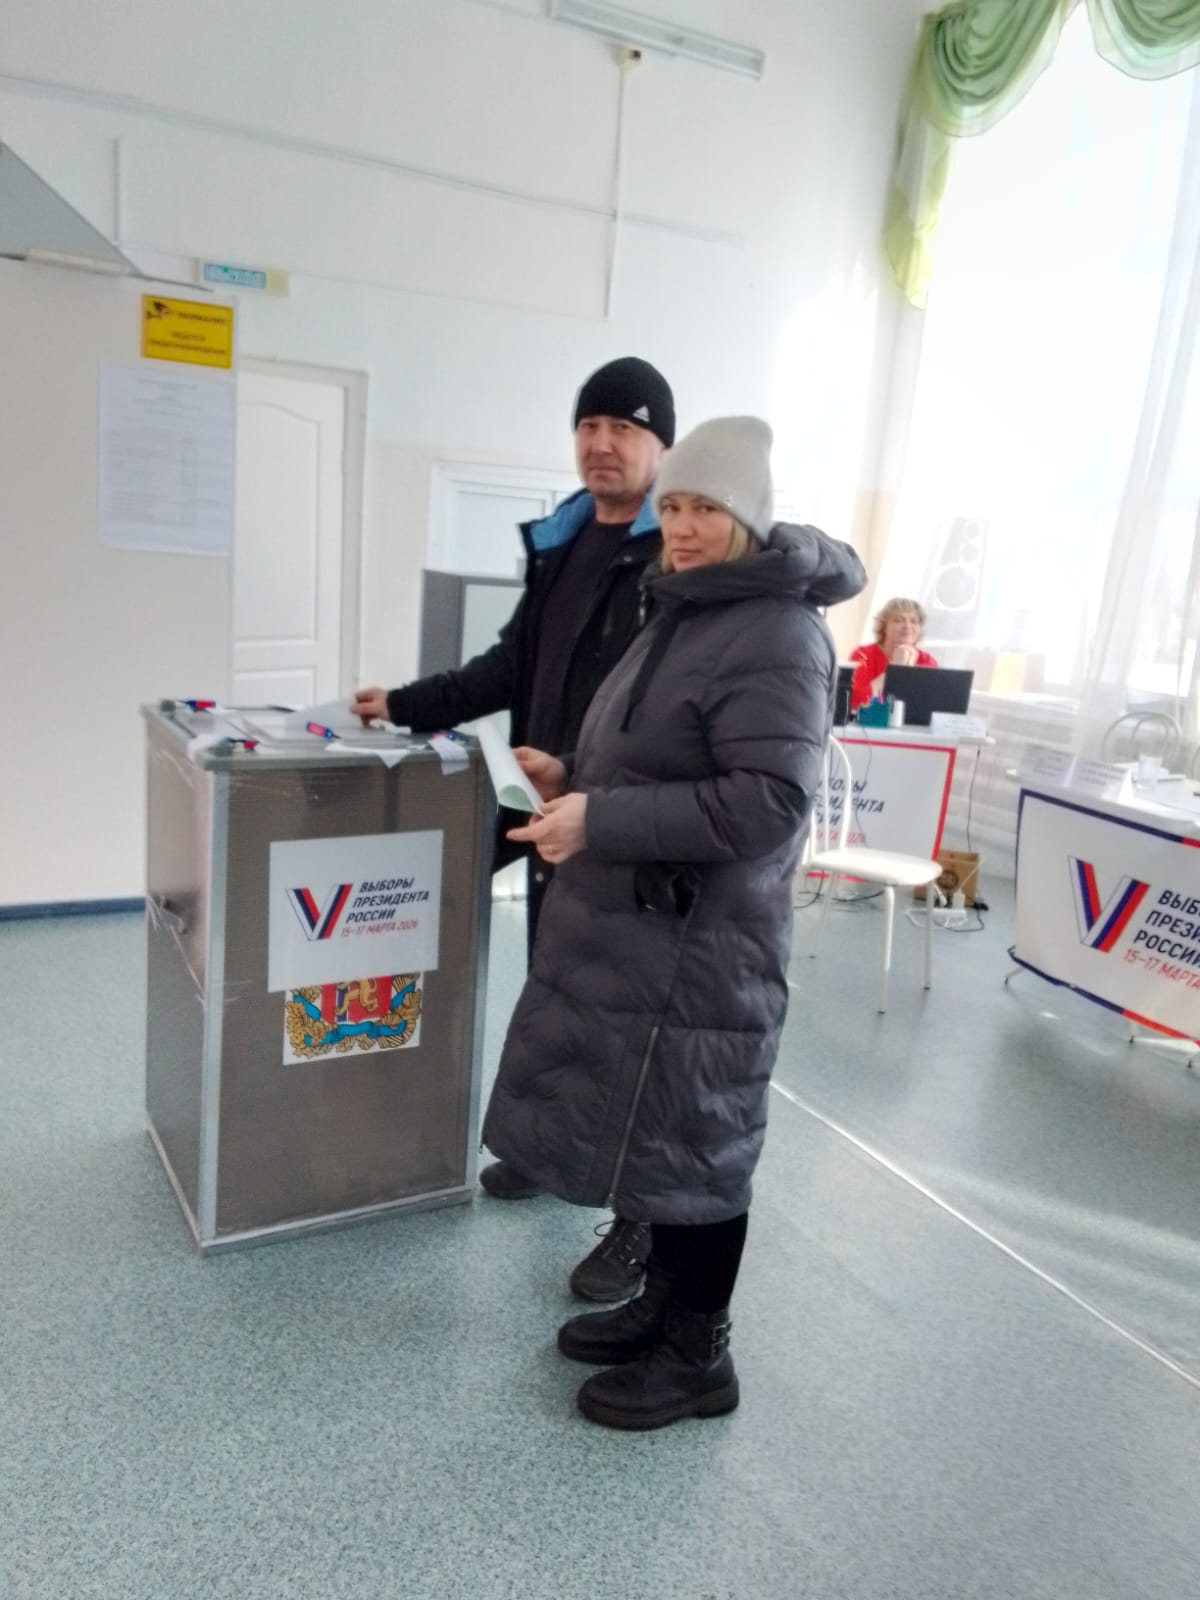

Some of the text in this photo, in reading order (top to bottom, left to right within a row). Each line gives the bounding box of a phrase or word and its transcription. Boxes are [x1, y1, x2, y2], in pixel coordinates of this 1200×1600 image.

[359, 877, 415, 893] ВЫБОРЫ
[352, 890, 430, 908] ПРЕЗИДЕНТА
[1158, 889, 1200, 916] ВЫБ
[345, 908, 396, 924] РОССИИ
[367, 921, 396, 934] МАРТА
